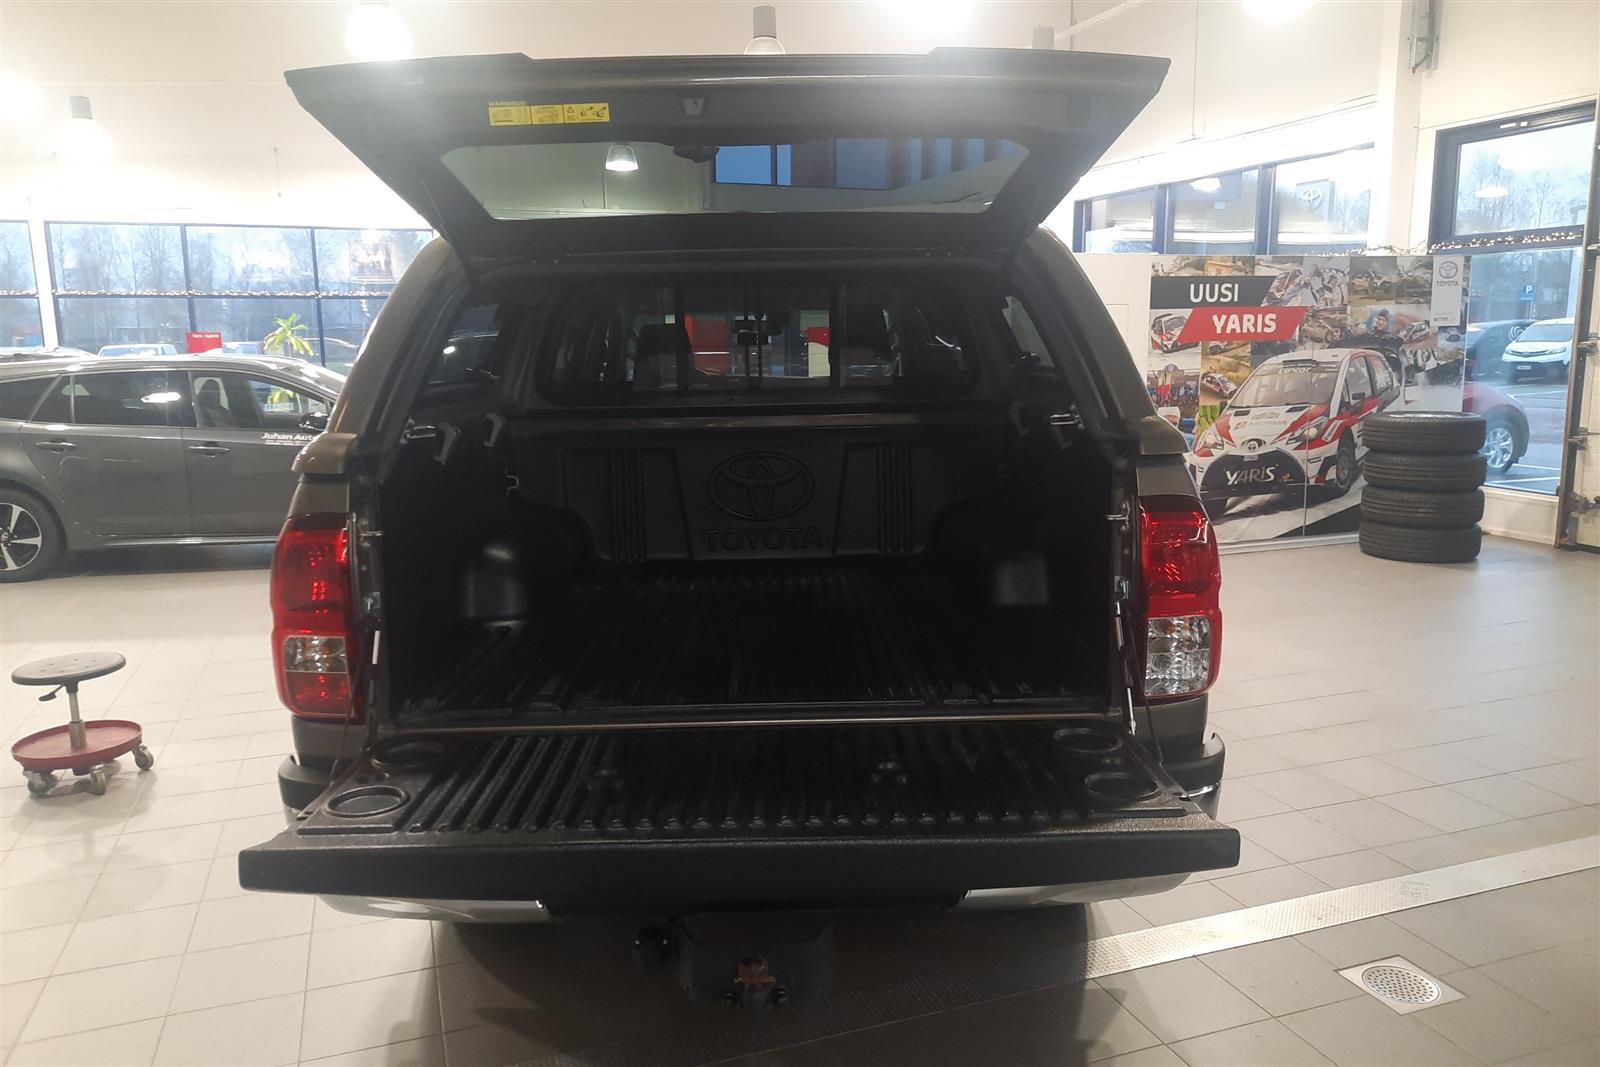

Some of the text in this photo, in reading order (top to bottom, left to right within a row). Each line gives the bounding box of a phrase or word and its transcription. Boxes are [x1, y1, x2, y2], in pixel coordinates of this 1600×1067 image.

[1189, 283, 1239, 304] UUSI
[1436, 280, 1460, 288] TOYOTA
[1212, 313, 1277, 334] YARIS
[261, 432, 293, 440] Juhan
[703, 526, 823, 551] TOYOTA
